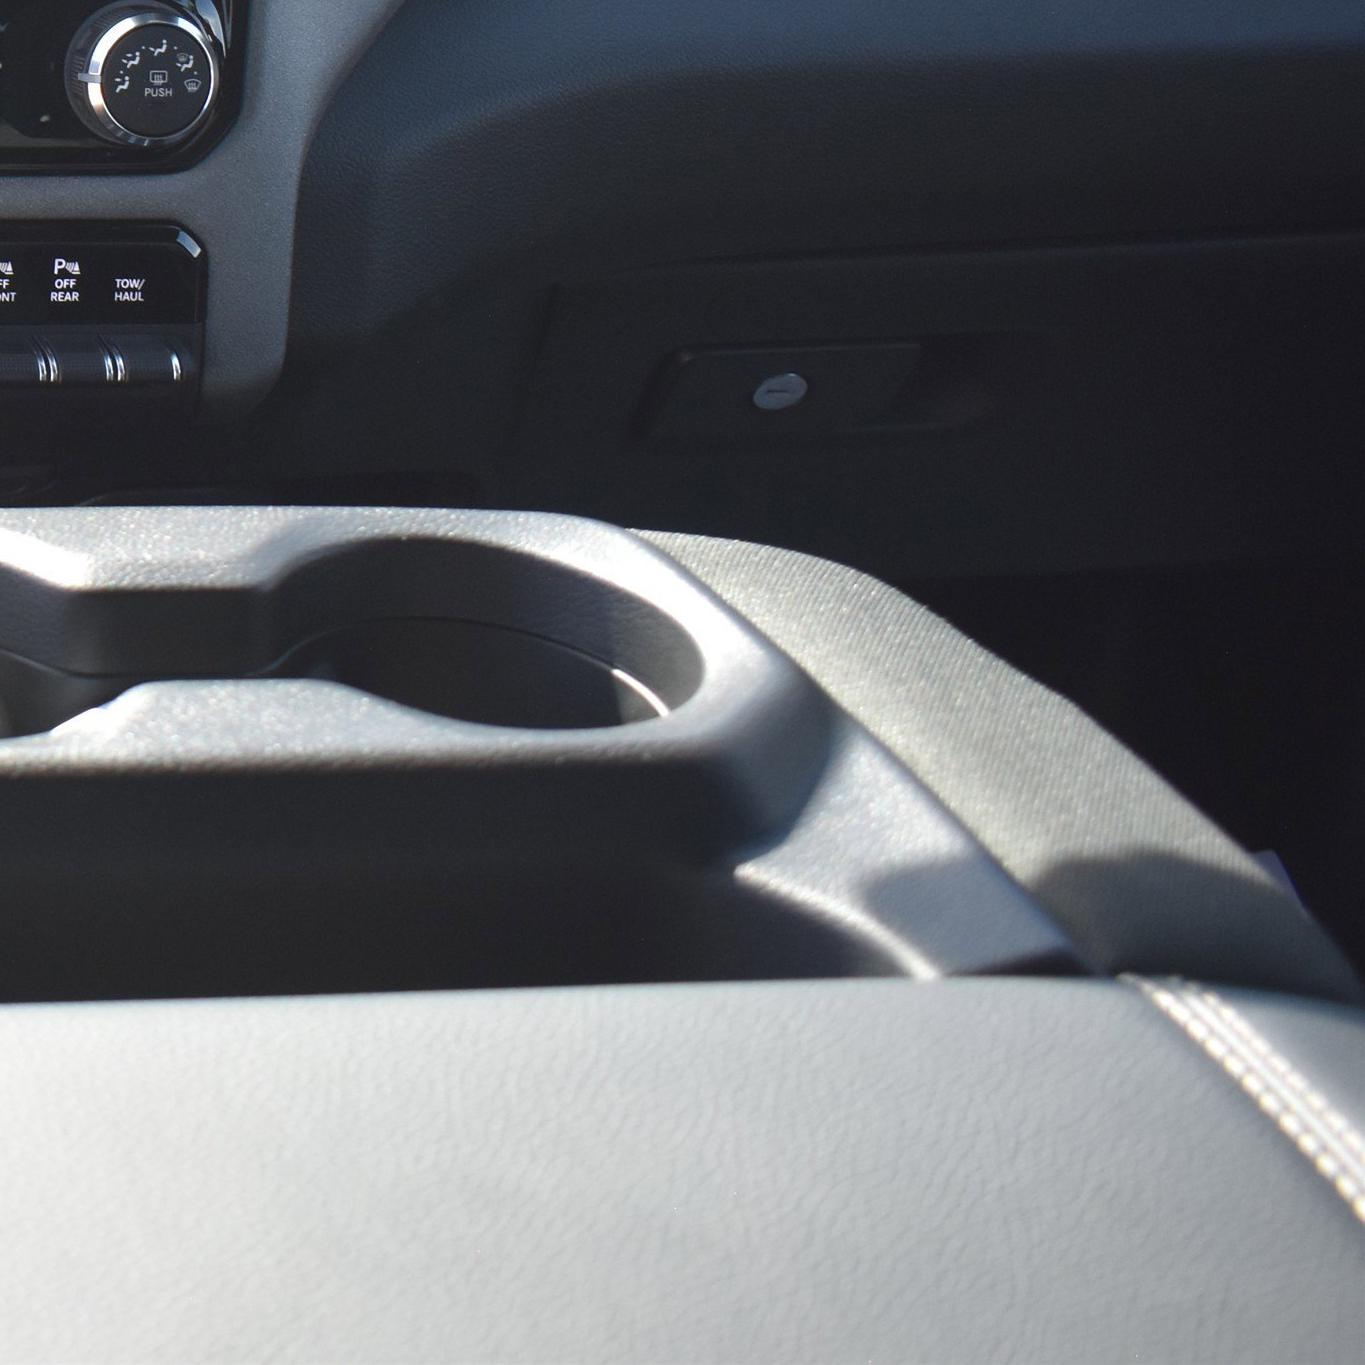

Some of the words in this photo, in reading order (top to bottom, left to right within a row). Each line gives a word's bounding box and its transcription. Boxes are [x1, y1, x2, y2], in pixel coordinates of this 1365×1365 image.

[144, 87, 173, 98] PUSH
[54, 278, 77, 289] OFF
[115, 278, 145, 290] TOW/
[50, 291, 80, 302] REAR
[114, 291, 145, 302] HAUL
